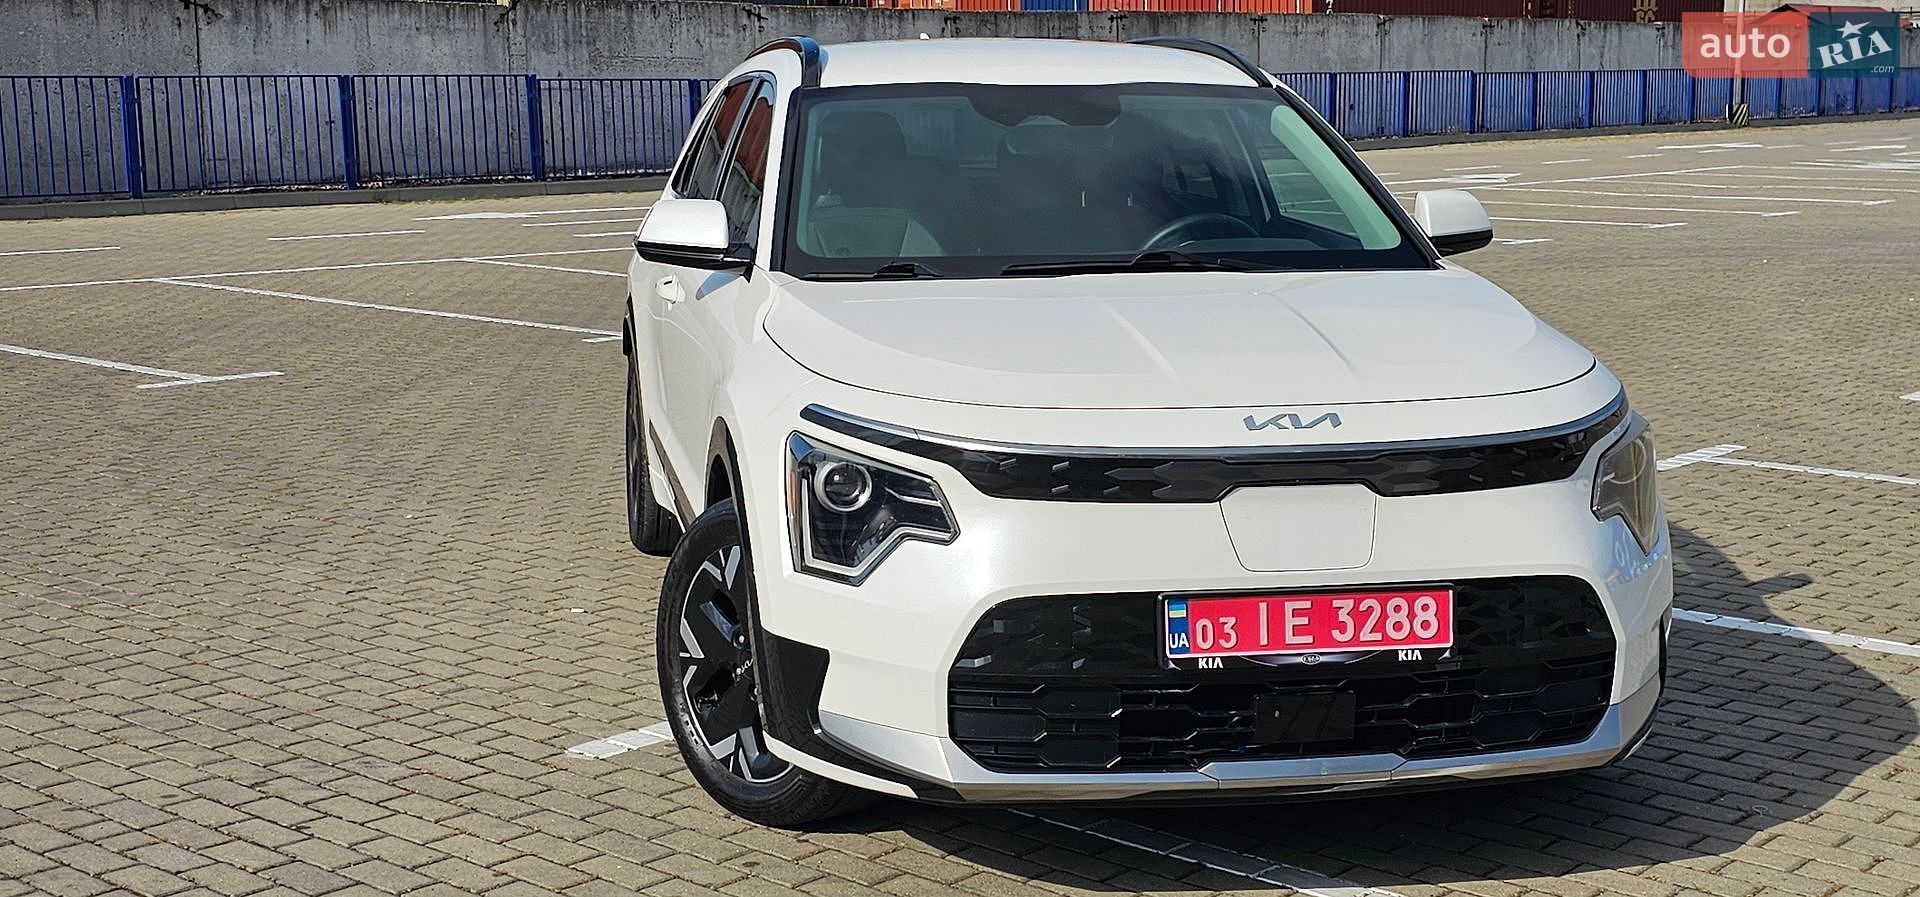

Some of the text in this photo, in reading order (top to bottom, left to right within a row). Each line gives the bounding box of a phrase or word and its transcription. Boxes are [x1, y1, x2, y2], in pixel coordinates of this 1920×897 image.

[1195, 596, 1440, 650] 03 IE 3288
[1168, 632, 1190, 649] UA
[1198, 656, 1224, 670] KIA
[1398, 649, 1422, 662] KIA
